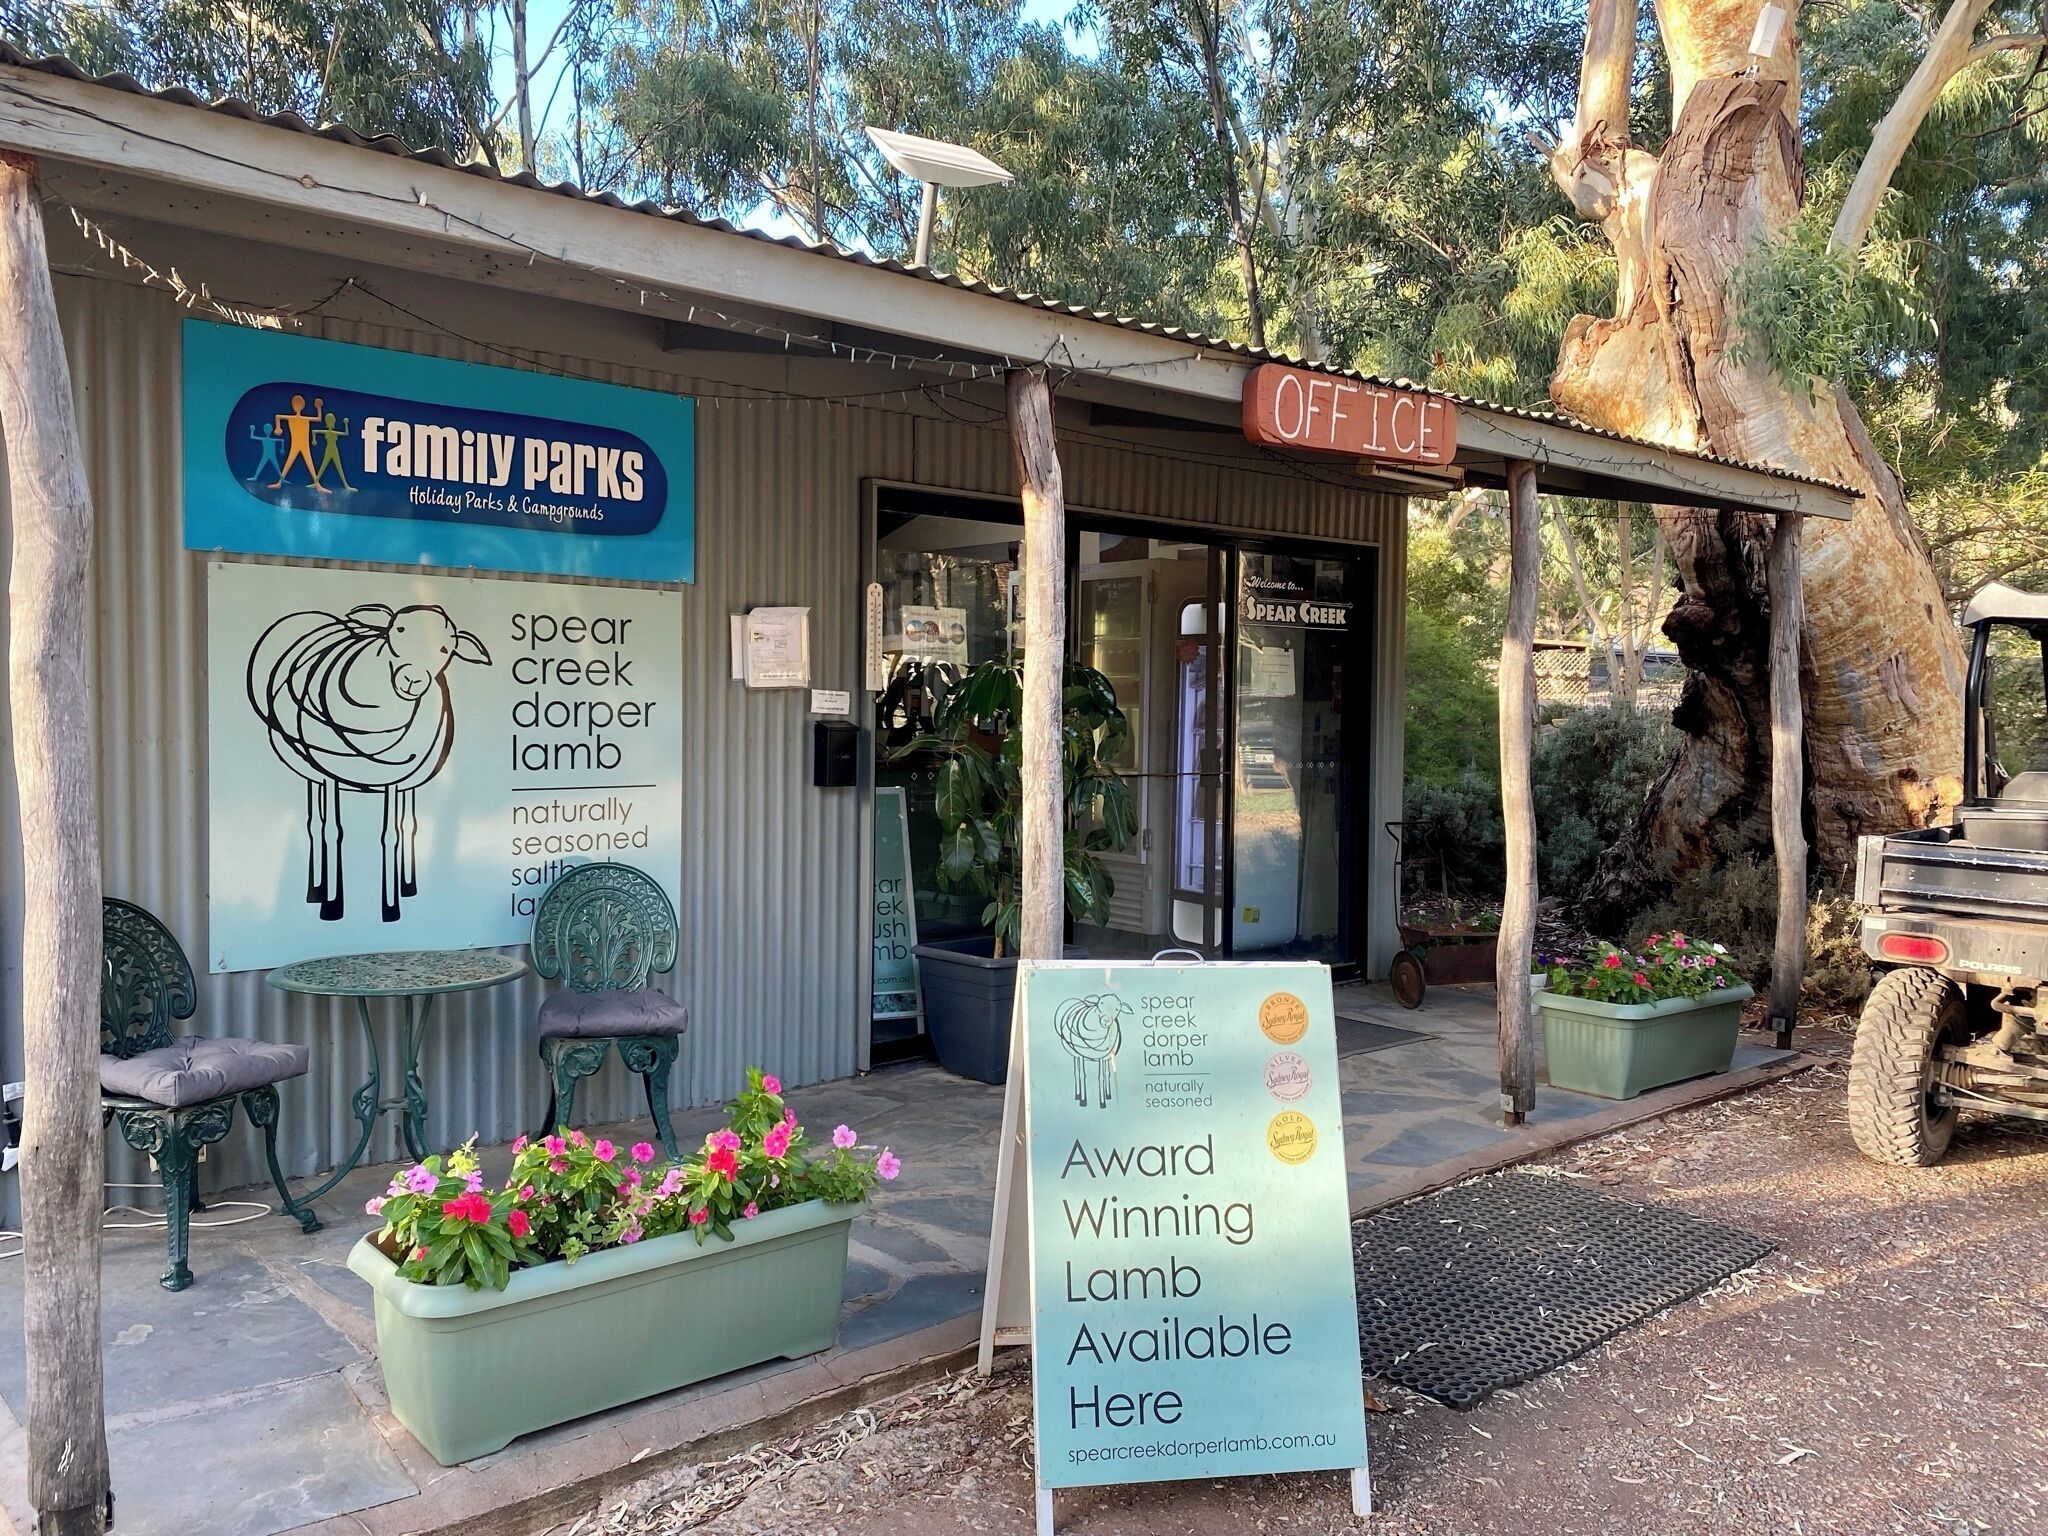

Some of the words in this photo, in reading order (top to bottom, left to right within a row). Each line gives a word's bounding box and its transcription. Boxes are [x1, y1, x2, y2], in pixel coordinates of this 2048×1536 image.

[1274, 373, 1442, 459] OFFICE
[361, 416, 516, 487] family
[523, 437, 644, 502] parks
[409, 485, 462, 514] Holiday
[465, 490, 504, 512] Parks
[507, 494, 519, 513] &
[522, 496, 605, 523] Campgrounds
[1250, 575, 1287, 590] Welcome
[1287, 580, 1304, 591] to...
[1246, 595, 1297, 623] SPEAR
[1299, 601, 1347, 625] CREEK
[511, 612, 632, 650] spear
[511, 651, 634, 687] creek
[511, 691, 656, 736] dorper
[511, 734, 622, 771] lamb
[511, 797, 633, 826] naturally
[511, 825, 649, 856] seasoned
[511, 892, 541, 917] la
[1959, 959, 2023, 975] POLARIS
[1141, 993, 1195, 1012] spear
[1264, 996, 1300, 1011] BRONZE
[1286, 1007, 1305, 1023] Royal
[1142, 1010, 1197, 1029] creek
[1143, 1031, 1209, 1051] dorper
[1143, 1049, 1194, 1068] lamb
[1269, 1055, 1302, 1070] SILVER
[1145, 1079, 1204, 1095] naturally
[1290, 1066, 1310, 1081] Royal
[1145, 1093, 1213, 1109] seasoned
[1275, 1114, 1303, 1127] GOLD
[1295, 1125, 1314, 1142] Royal
[1061, 1133, 1215, 1180] Award
[1063, 1193, 1254, 1245] Winning
[1066, 1255, 1202, 1303] Lamb
[1067, 1313, 1293, 1366] Available
[1070, 1384, 1184, 1430] Here
[1068, 1432, 1337, 1466] spearcreekdorperlamb.com.au
